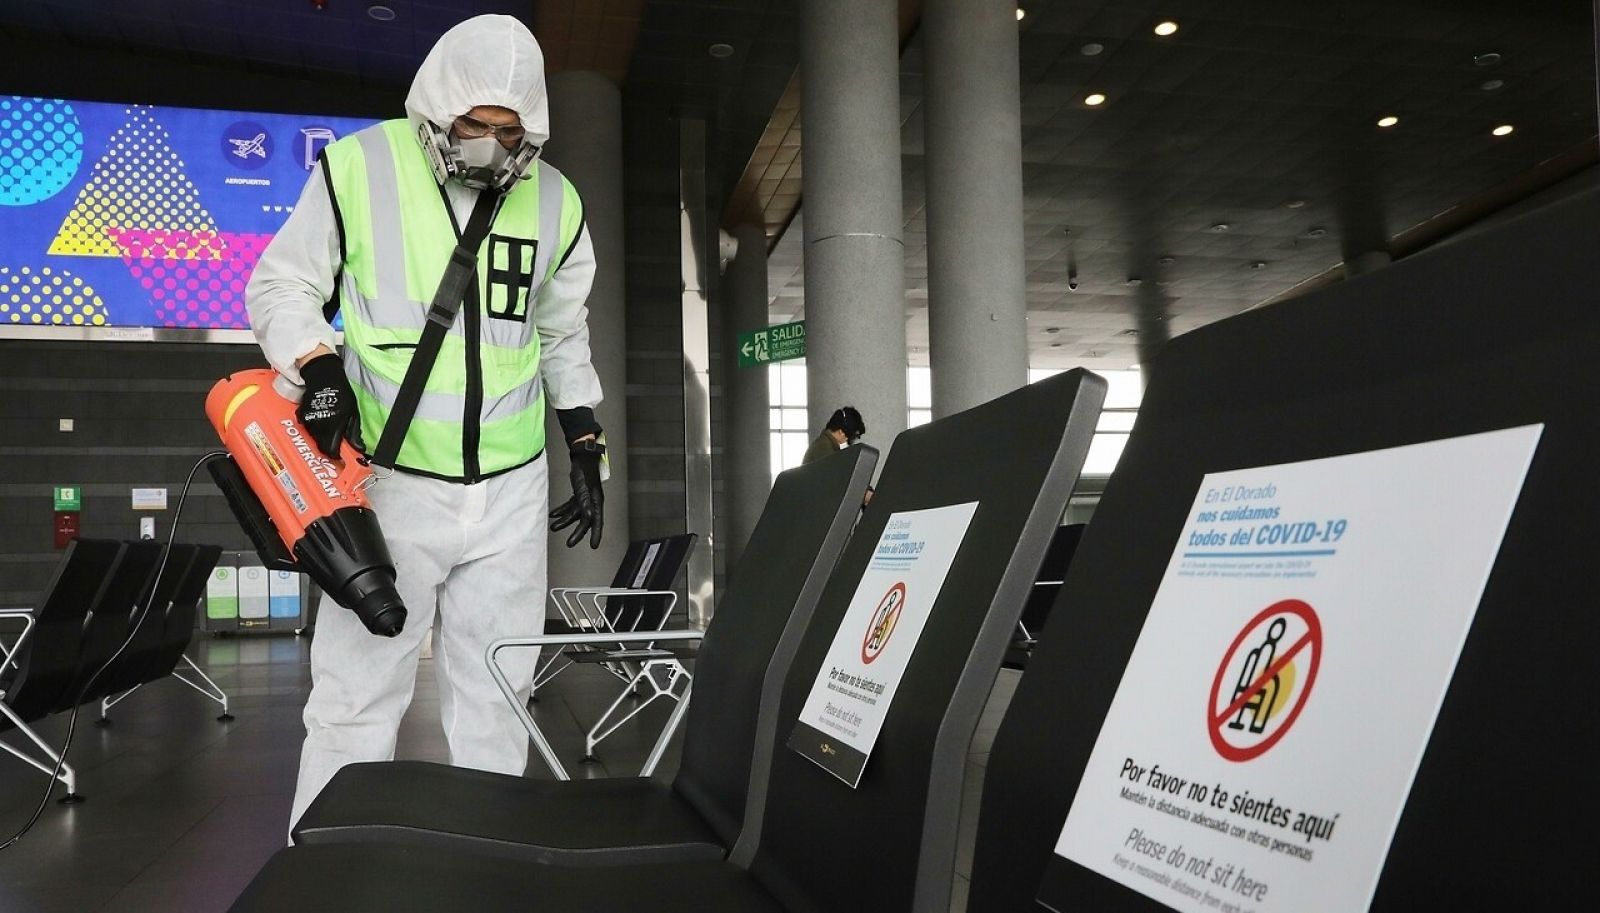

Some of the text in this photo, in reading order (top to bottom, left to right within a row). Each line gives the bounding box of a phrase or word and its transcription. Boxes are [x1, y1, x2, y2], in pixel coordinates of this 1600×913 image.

[225, 178, 271, 186] AEROPUERTOS
[772, 324, 806, 342] SALID
[779, 338, 806, 349] EMERGENC
[280, 419, 341, 498] POWERCLEAN
[1204, 482, 1277, 503] En El Dorado
[1196, 505, 1281, 523] nos cuidamos
[1188, 518, 1348, 546] todos del COVID-19
[1119, 757, 1340, 842] Por favor no te sientes aquí
[1120, 786, 1315, 862] Mantén la distancia adecuada con otras personas
[1124, 827, 1269, 902] Please do not sit here
